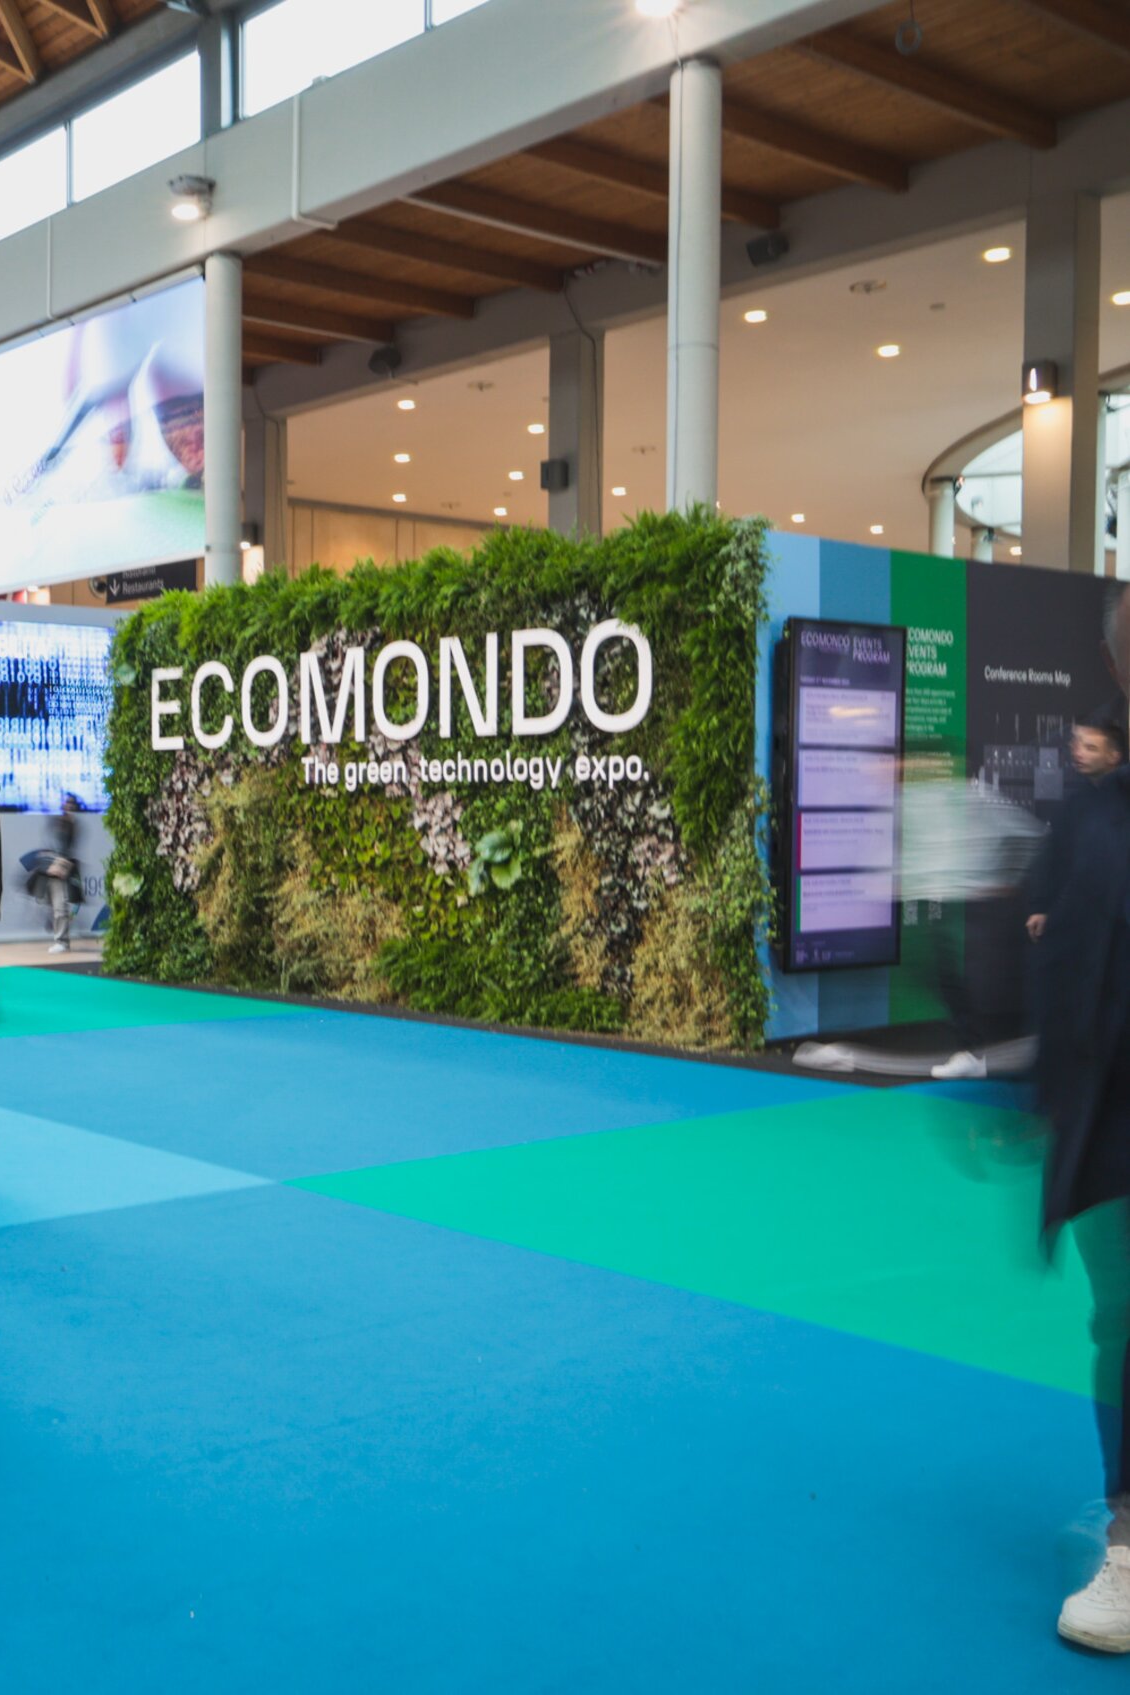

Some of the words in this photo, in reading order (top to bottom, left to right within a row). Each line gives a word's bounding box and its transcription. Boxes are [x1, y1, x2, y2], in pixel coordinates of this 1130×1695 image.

[800, 630, 850, 650] ECOMONDO
[853, 635, 882, 650] EVENTS
[907, 627, 953, 647] COMONDO
[852, 648, 890, 664] PROGRAM
[907, 643, 937, 660] VENTS
[151, 618, 653, 751] ECOMONDO
[984, 665, 1027, 683] Conference
[1028, 667, 1054, 684] Rooms
[1054, 670, 1071, 687] Map
[301, 756, 339, 785] The
[344, 758, 408, 792] green
[419, 751, 562, 790] technology
[575, 754, 650, 789] expo.
